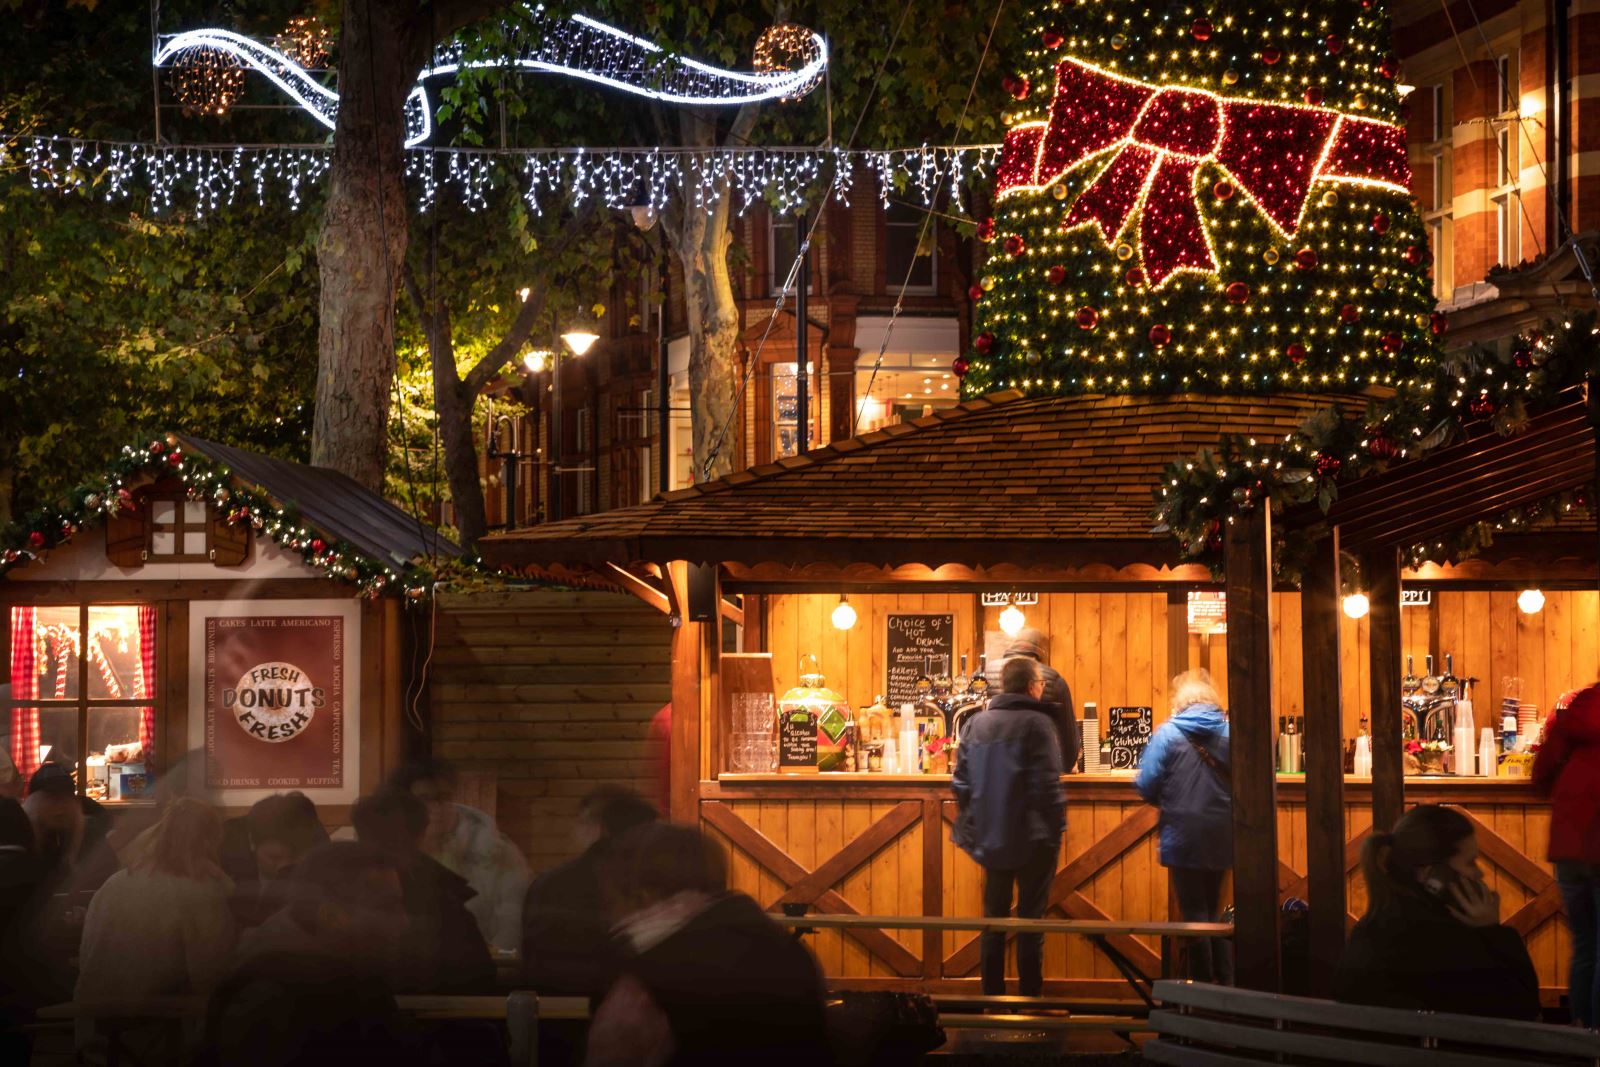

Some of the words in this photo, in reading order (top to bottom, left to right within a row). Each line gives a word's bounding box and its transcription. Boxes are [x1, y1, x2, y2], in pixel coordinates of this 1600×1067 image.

[219, 619, 246, 627] CAKES
[250, 619, 276, 627] LATTE
[281, 618, 331, 627] AMERICANO
[888, 616, 926, 631] Choice
[931, 618, 942, 631] of
[905, 628, 926, 640] HOT
[208, 618, 216, 664] BROWNIES
[333, 619, 341, 660] ESPRESSO
[208, 668, 216, 702] DONUTS
[250, 667, 300, 684] FRESH
[333, 665, 341, 696] MOCHA
[222, 687, 326, 710] DONUTS
[239, 710, 310, 740] FRESH
[333, 701, 341, 753] CAPPUCCINO
[332, 758, 340, 775] TEA
[230, 778, 260, 786] DRINKS
[268, 778, 300, 786] COOKIES
[306, 777, 340, 786] MUFFINS
